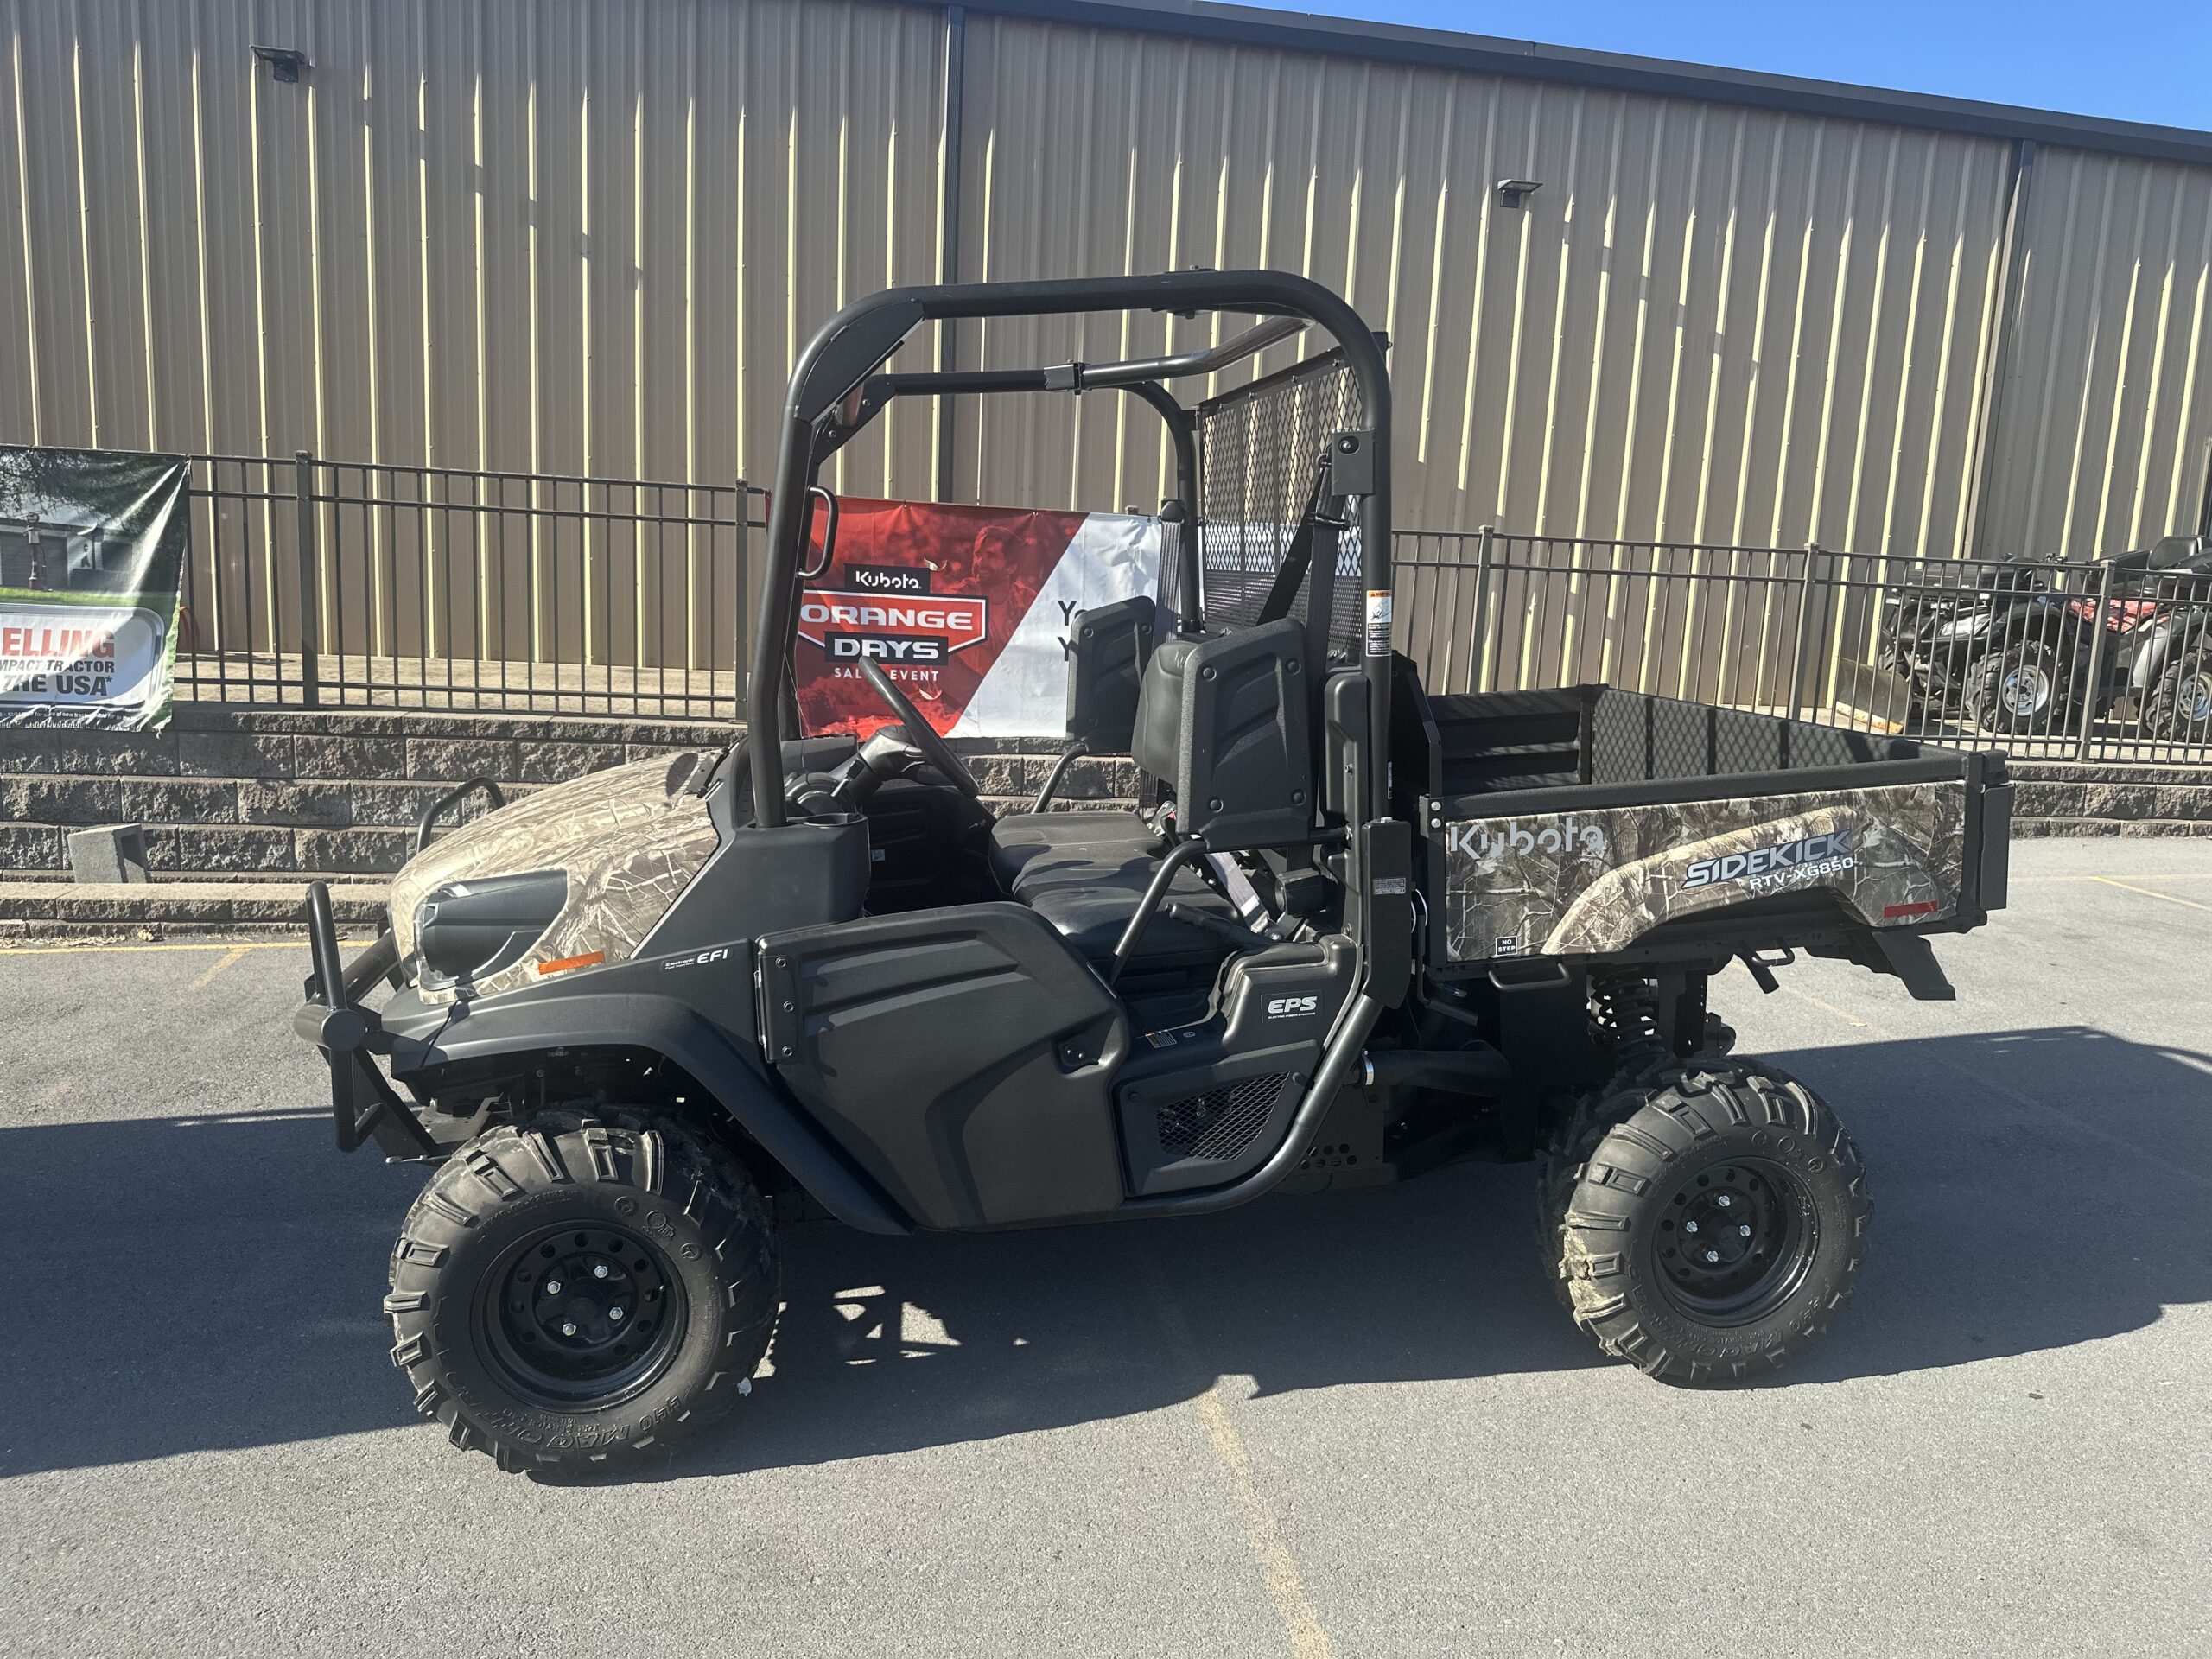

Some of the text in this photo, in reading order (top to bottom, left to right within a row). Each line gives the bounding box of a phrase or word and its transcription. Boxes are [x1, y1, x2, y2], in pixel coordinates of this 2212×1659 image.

[855, 570, 919, 589] Kubota
[800, 604, 973, 631] ORANGE
[1058, 601, 1087, 626] Y
[2, 627, 115, 658] ELLING
[834, 639, 939, 659] DAYS
[47, 660, 115, 673] TRACTOR
[835, 667, 939, 681] SAL EVENT
[1450, 817, 1605, 860] Kubota
[1682, 830, 1853, 889] SIDEKICK
[1749, 856, 1854, 890] RTV-XG850
[697, 948, 728, 964] EFI
[1268, 996, 1318, 1014] EPS
